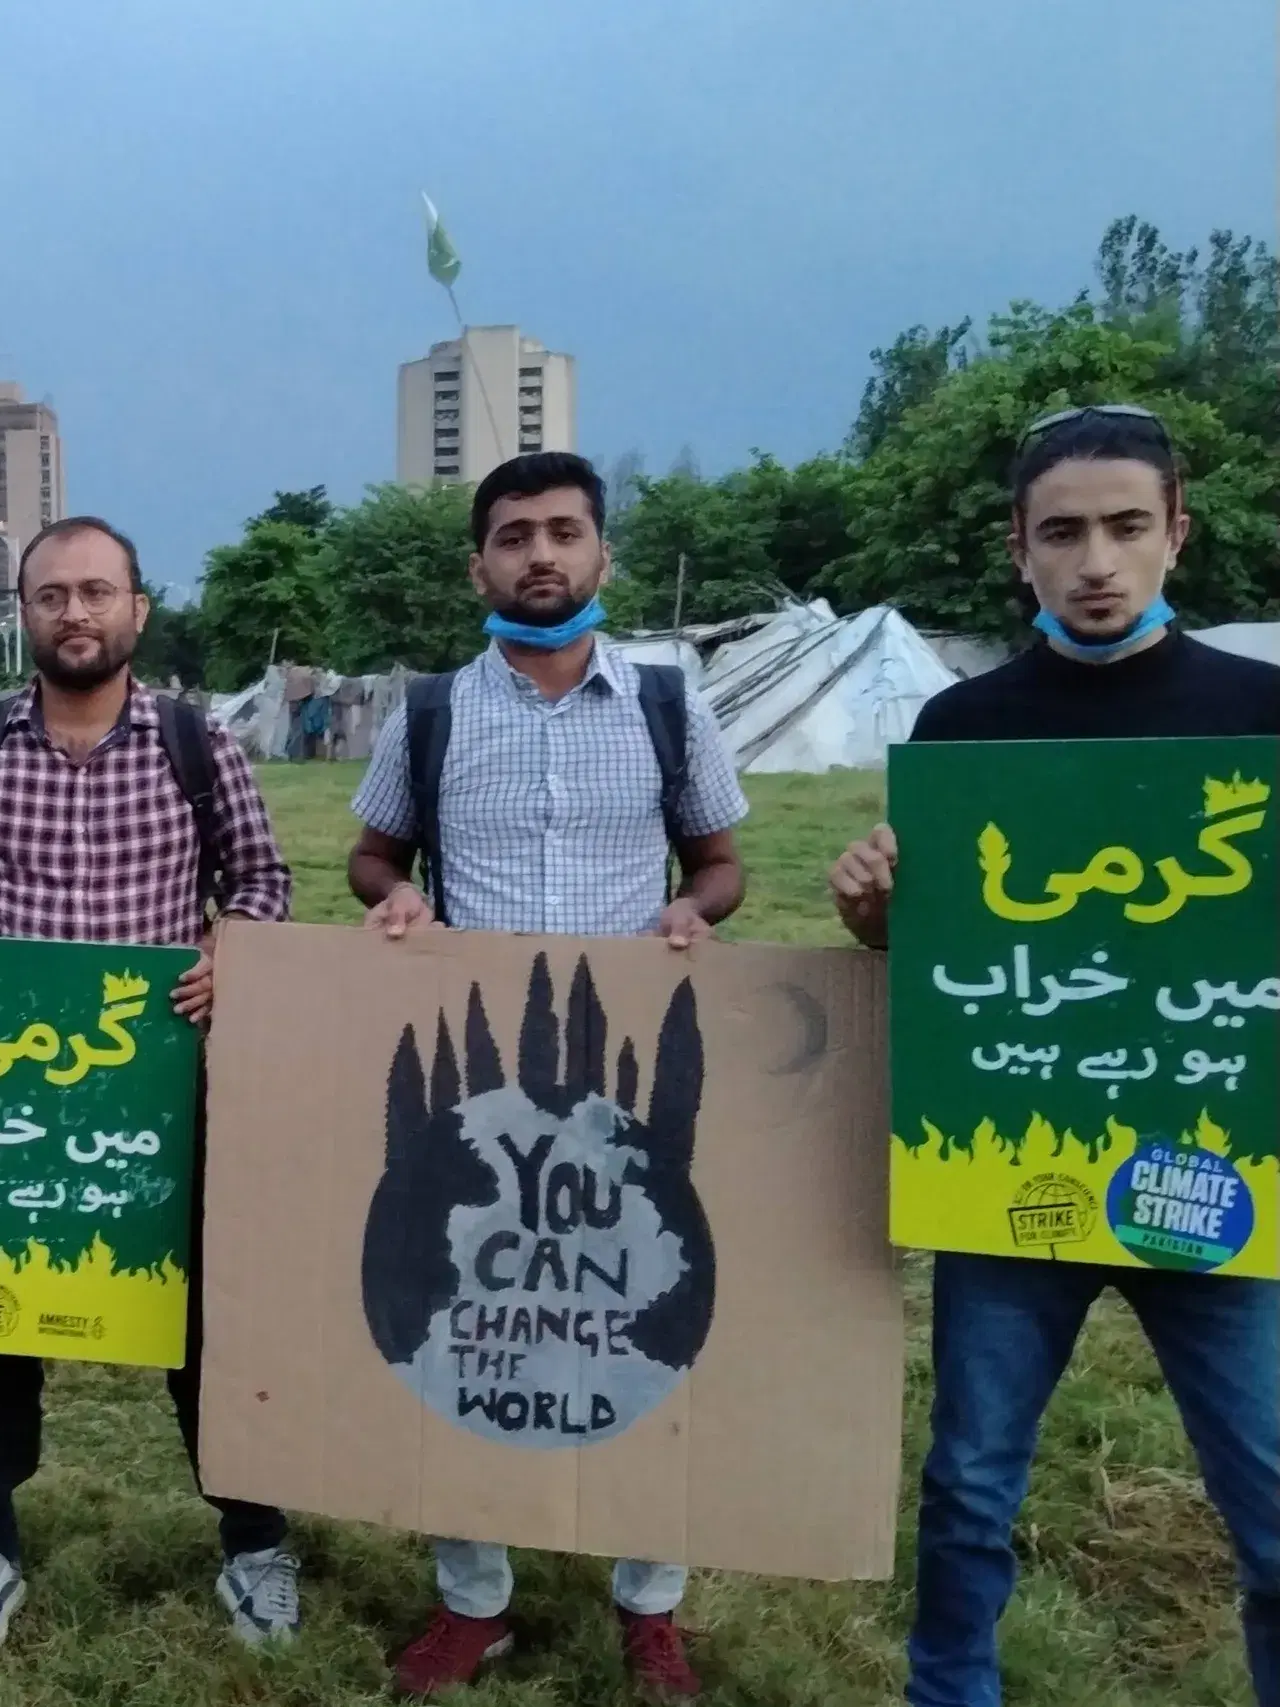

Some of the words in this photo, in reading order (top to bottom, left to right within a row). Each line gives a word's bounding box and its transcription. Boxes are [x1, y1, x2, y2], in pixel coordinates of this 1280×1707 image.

[978, 768, 1271, 923] گرمی
[932, 944, 1130, 1017] خراب
[1155, 977, 1280, 1028] میں
[971, 1038, 1061, 1080] ہیں
[1077, 1046, 1158, 1100] رہے
[1174, 1049, 1247, 1092] ہو
[65, 1129, 162, 1170] میں
[1150, 1147, 1225, 1174] GLOBAL
[494, 1133, 623, 1235] YOU
[1130, 1160, 1240, 1209] CLIMATE
[1017, 1209, 1074, 1231] STRIKE
[1133, 1193, 1225, 1240] STRIKE
[474, 1229, 629, 1298] CAN
[449, 1299, 632, 1357] CHANGE
[448, 1344, 526, 1380] THE
[457, 1386, 617, 1434] WORLD
